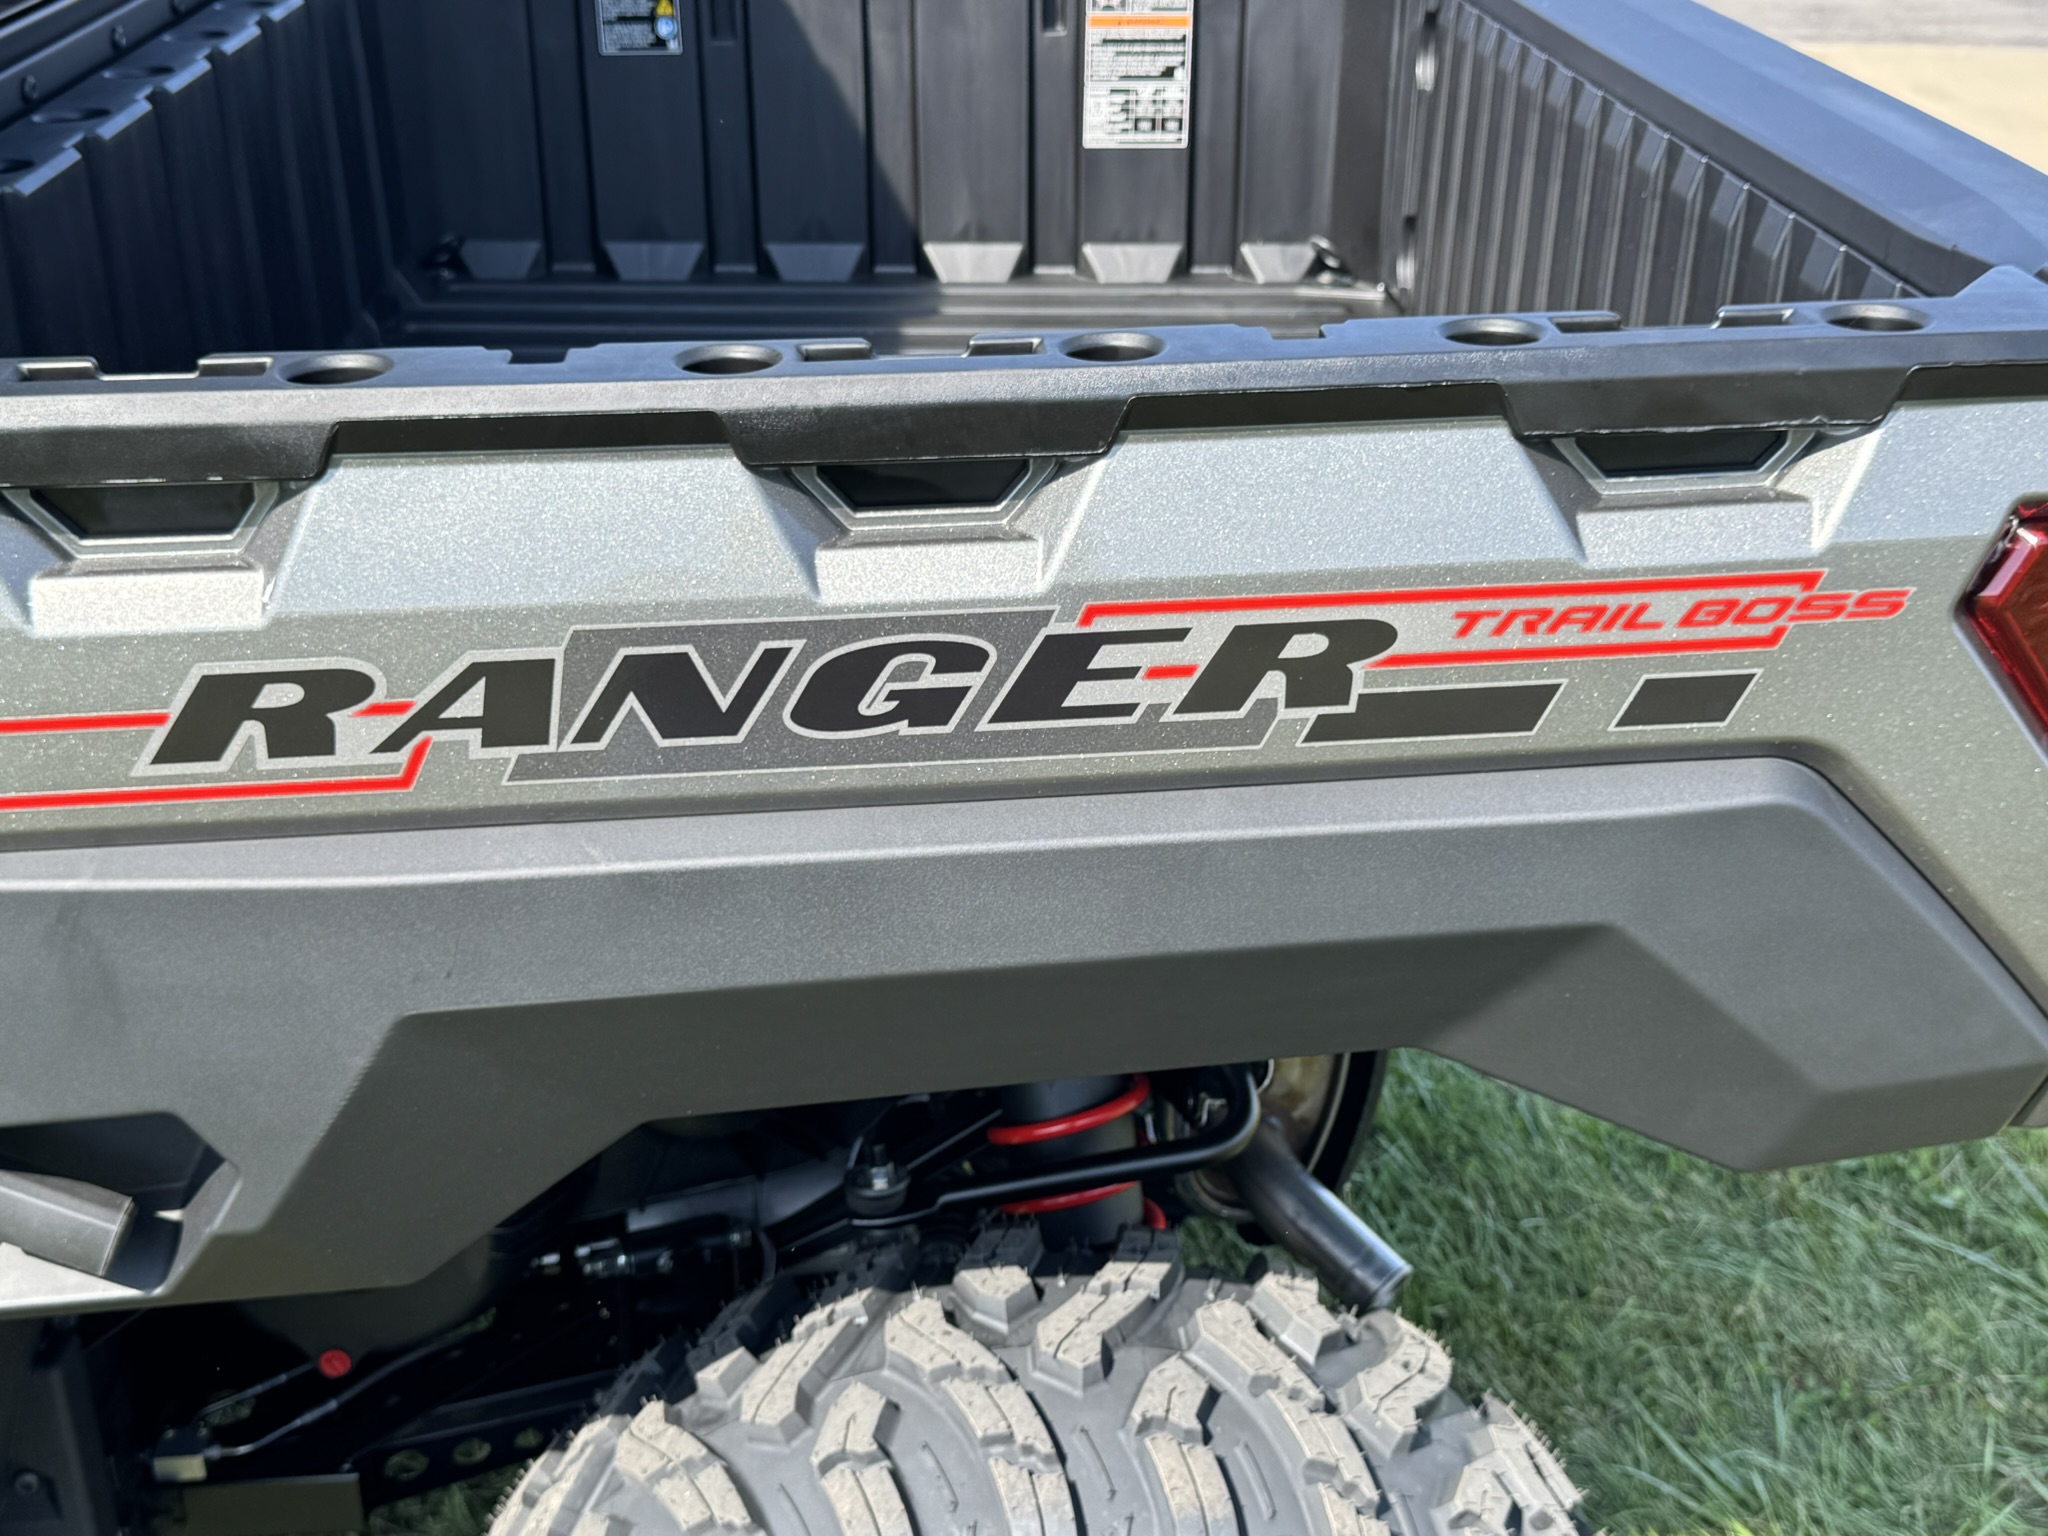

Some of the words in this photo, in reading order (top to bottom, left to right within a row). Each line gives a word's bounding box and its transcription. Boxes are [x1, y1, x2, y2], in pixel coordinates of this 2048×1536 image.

[1453, 602, 1663, 638] TRAIL
[1677, 589, 1912, 628] BOSS
[149, 618, 1398, 765] RANGER
